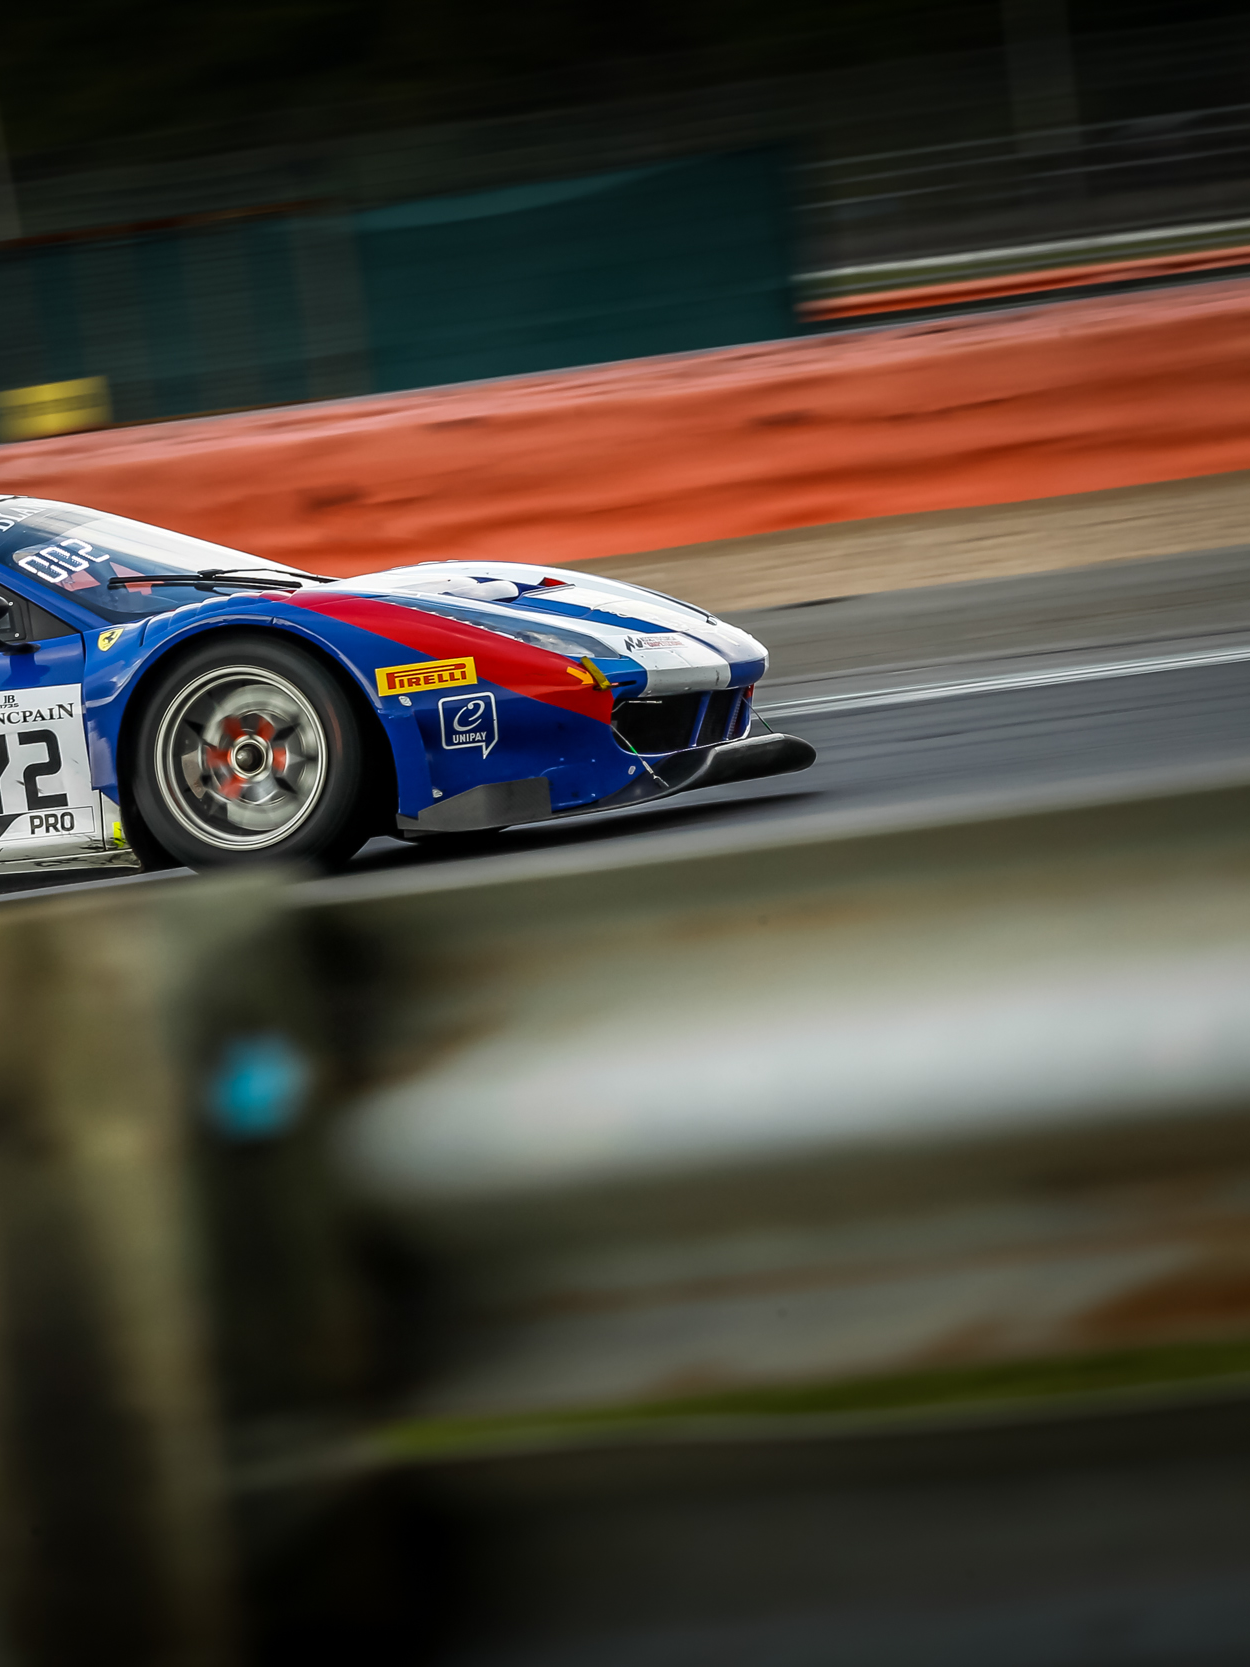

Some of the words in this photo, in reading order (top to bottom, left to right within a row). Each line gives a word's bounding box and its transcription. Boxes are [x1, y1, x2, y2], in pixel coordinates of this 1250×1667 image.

[386, 663, 467, 690] PIRELLI
[452, 731, 487, 743] UNIPAY
[29, 811, 75, 835] PRO
